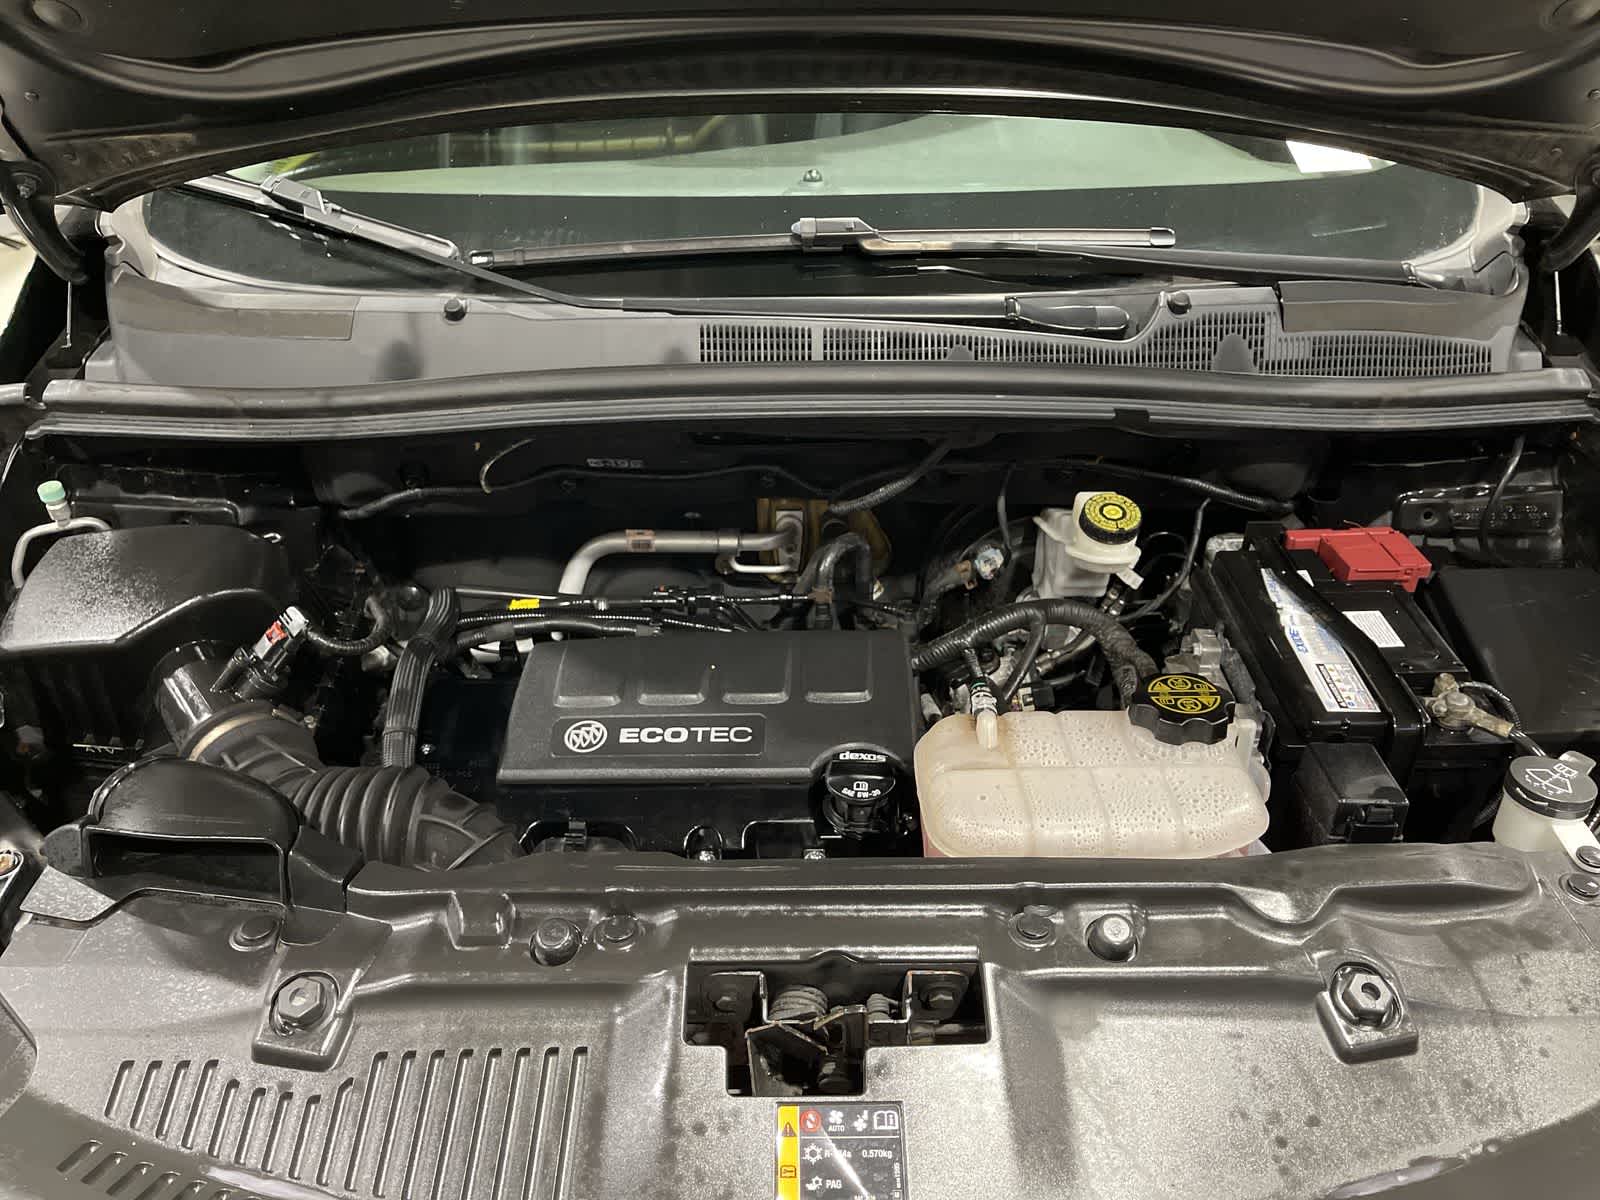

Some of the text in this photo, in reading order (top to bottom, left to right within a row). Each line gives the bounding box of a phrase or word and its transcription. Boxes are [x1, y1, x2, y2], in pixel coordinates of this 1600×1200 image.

[618, 726, 753, 743] ECOTEC
[839, 751, 886, 762] dexos
[861, 1149, 893, 1159] 0.570kg
[825, 1179, 842, 1189] PAG
